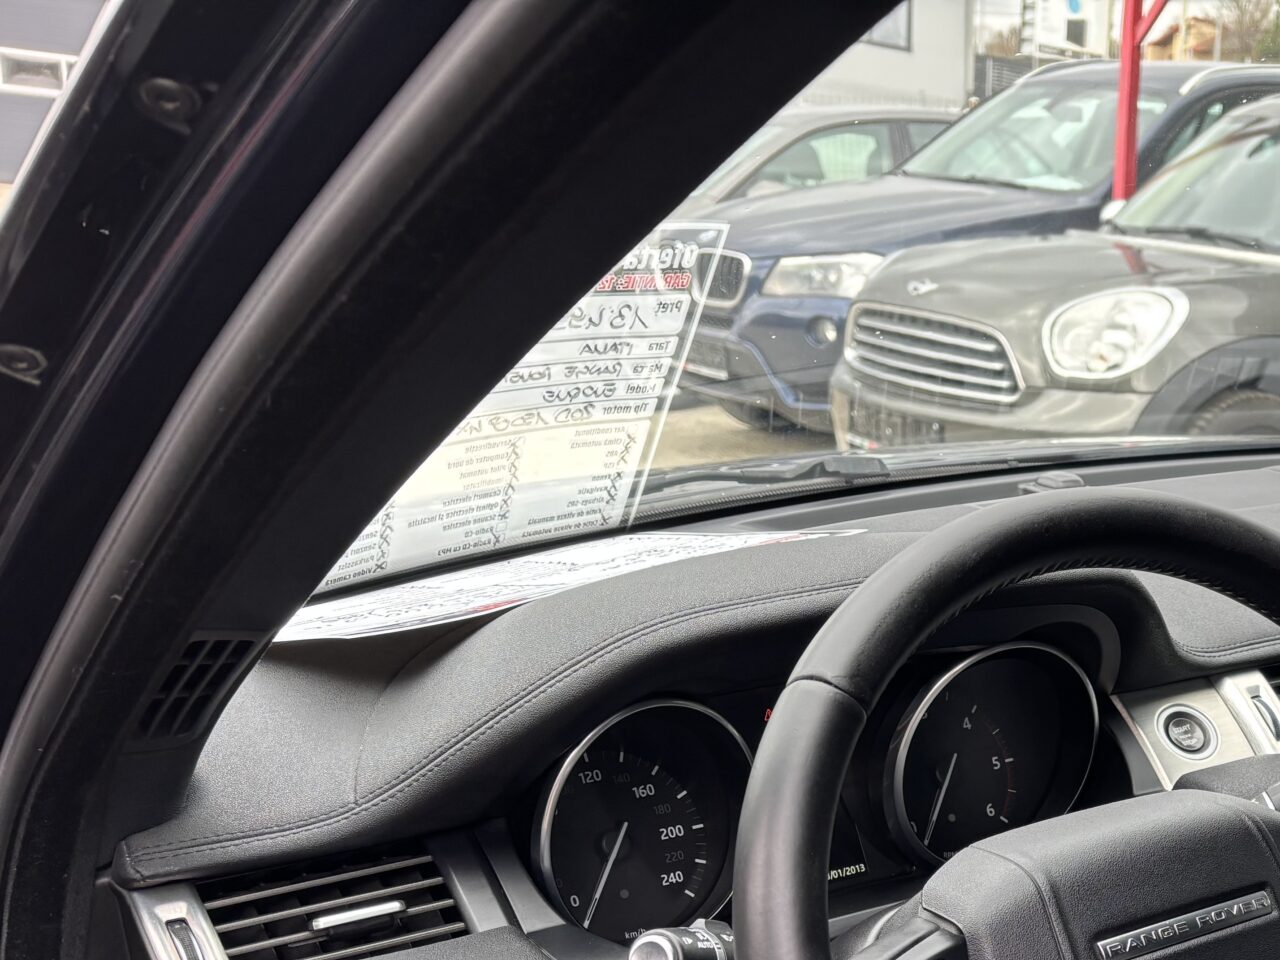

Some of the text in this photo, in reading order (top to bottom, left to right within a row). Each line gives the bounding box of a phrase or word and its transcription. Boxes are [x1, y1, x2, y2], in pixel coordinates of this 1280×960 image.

[962, 717, 972, 730] 4
[991, 756, 1001, 770] 5
[578, 769, 602, 785] 120
[632, 783, 655, 799] 160
[653, 803, 671, 816] 180
[986, 803, 996, 818] 6
[659, 824, 685, 841] 200
[665, 850, 685, 863] 220
[661, 871, 684, 886] 240
[569, 894, 580, 908] 0
[1106, 896, 1271, 957] RANGE ROVER
